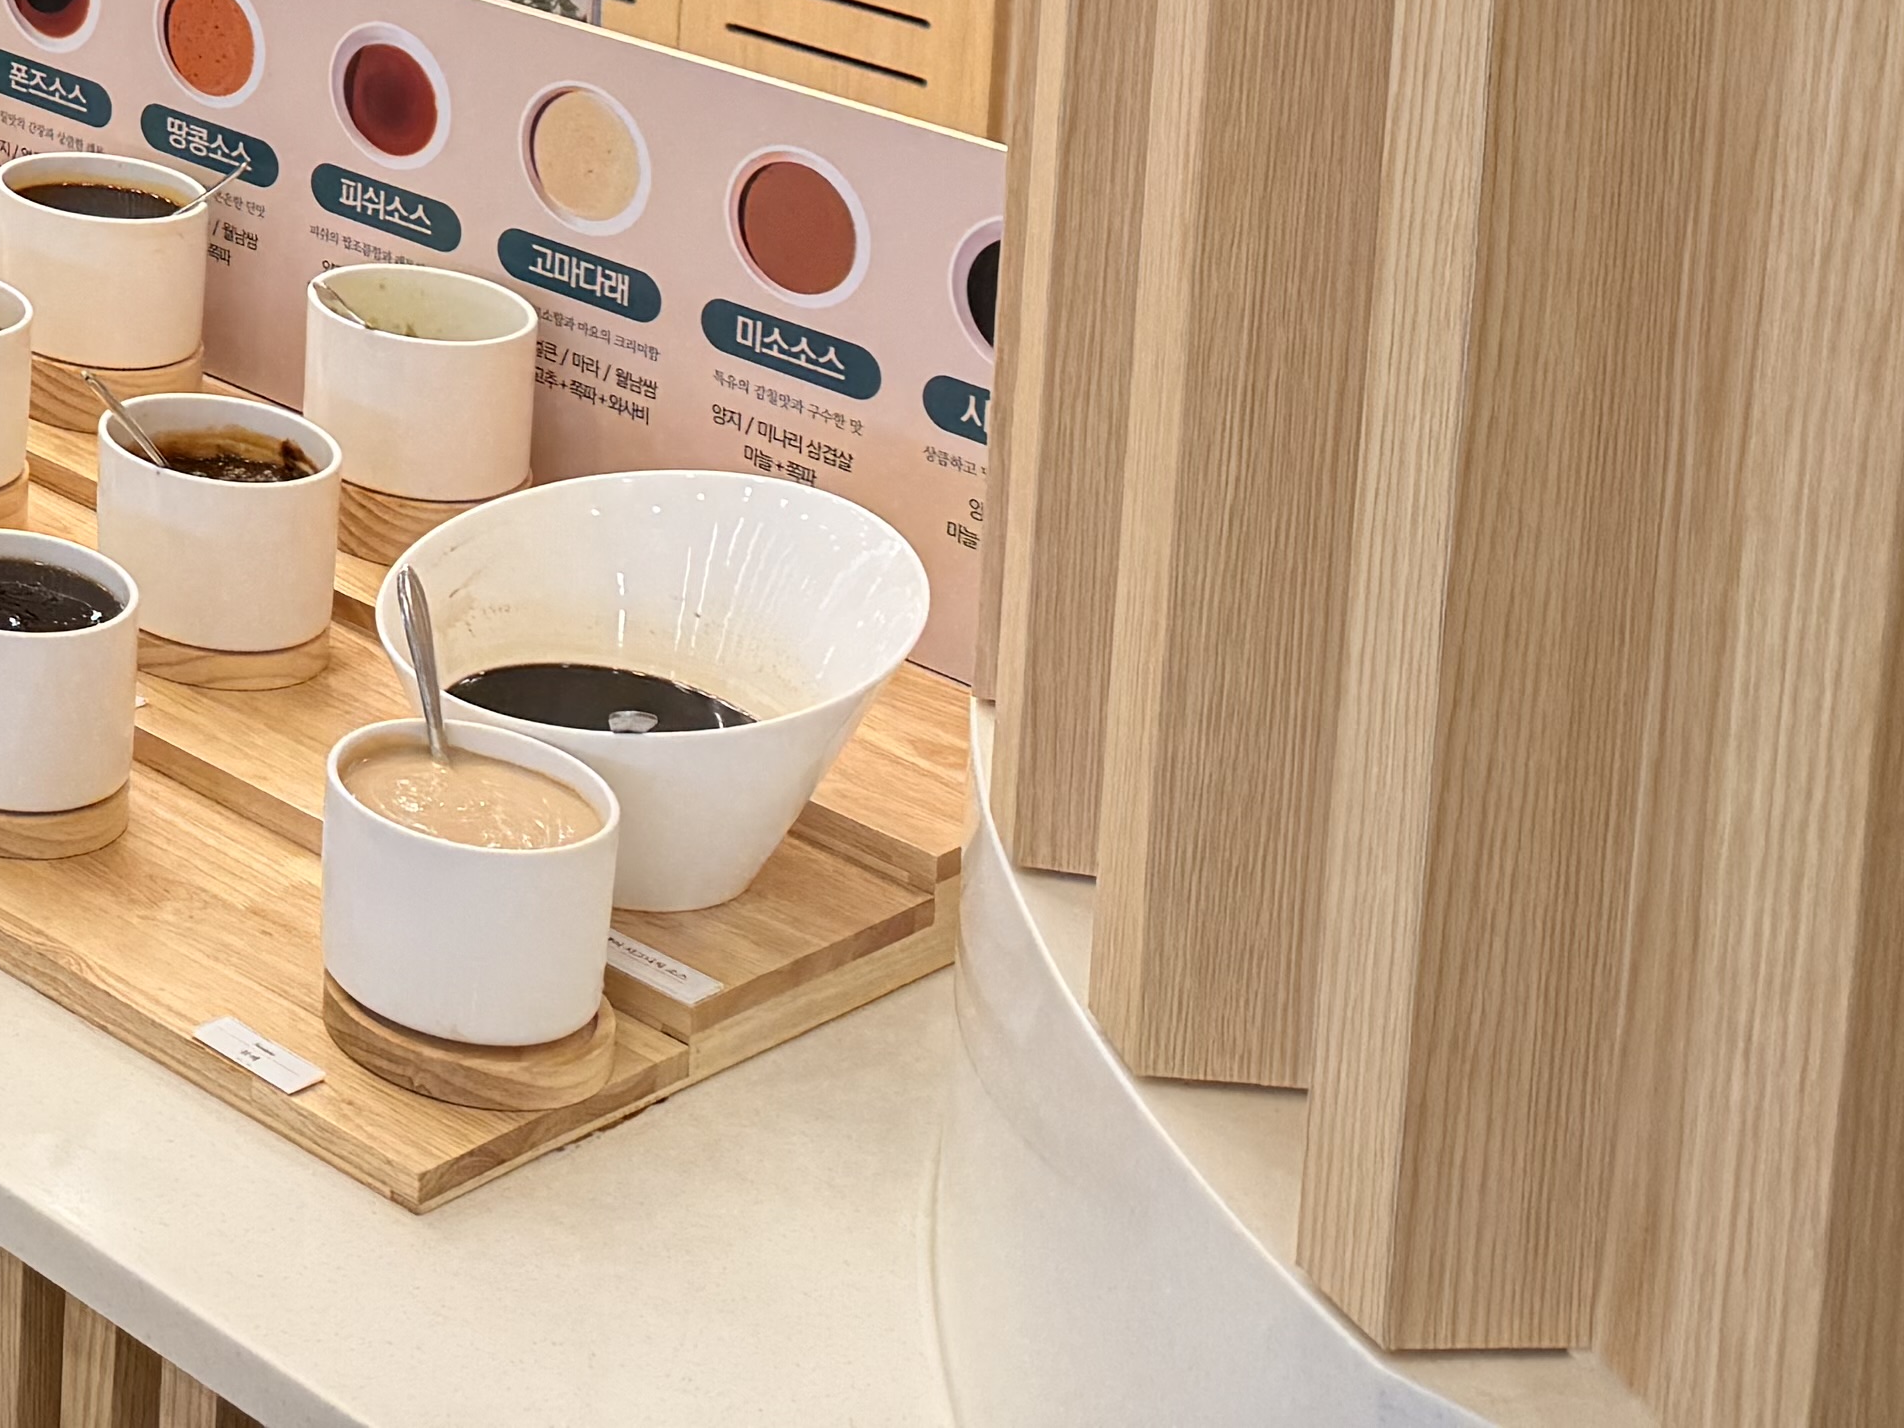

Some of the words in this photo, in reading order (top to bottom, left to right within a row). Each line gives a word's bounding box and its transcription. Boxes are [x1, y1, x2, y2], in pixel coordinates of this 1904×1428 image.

[8, 61, 88, 113] 폰즈소스
[166, 116, 254, 172] 땅콩소스
[339, 177, 433, 236] 피쉬소스
[221, 221, 259, 251] 월남쌈
[309, 224, 339, 246] 피쉬의
[528, 243, 631, 307] 고마다래
[537, 307, 576, 332] 소함과
[577, 320, 611, 346] 마요의
[736, 314, 846, 381] 미소소스
[572, 351, 601, 380] 마라
[615, 366, 659, 400] 월남쌈
[713, 368, 750, 395] 특유의
[807, 402, 847, 431] 구수한
[849, 418, 865, 437] 맛
[711, 403, 742, 432] 양지
[757, 420, 803, 454] 미나리
[923, 445, 978, 477] 상큼하고
